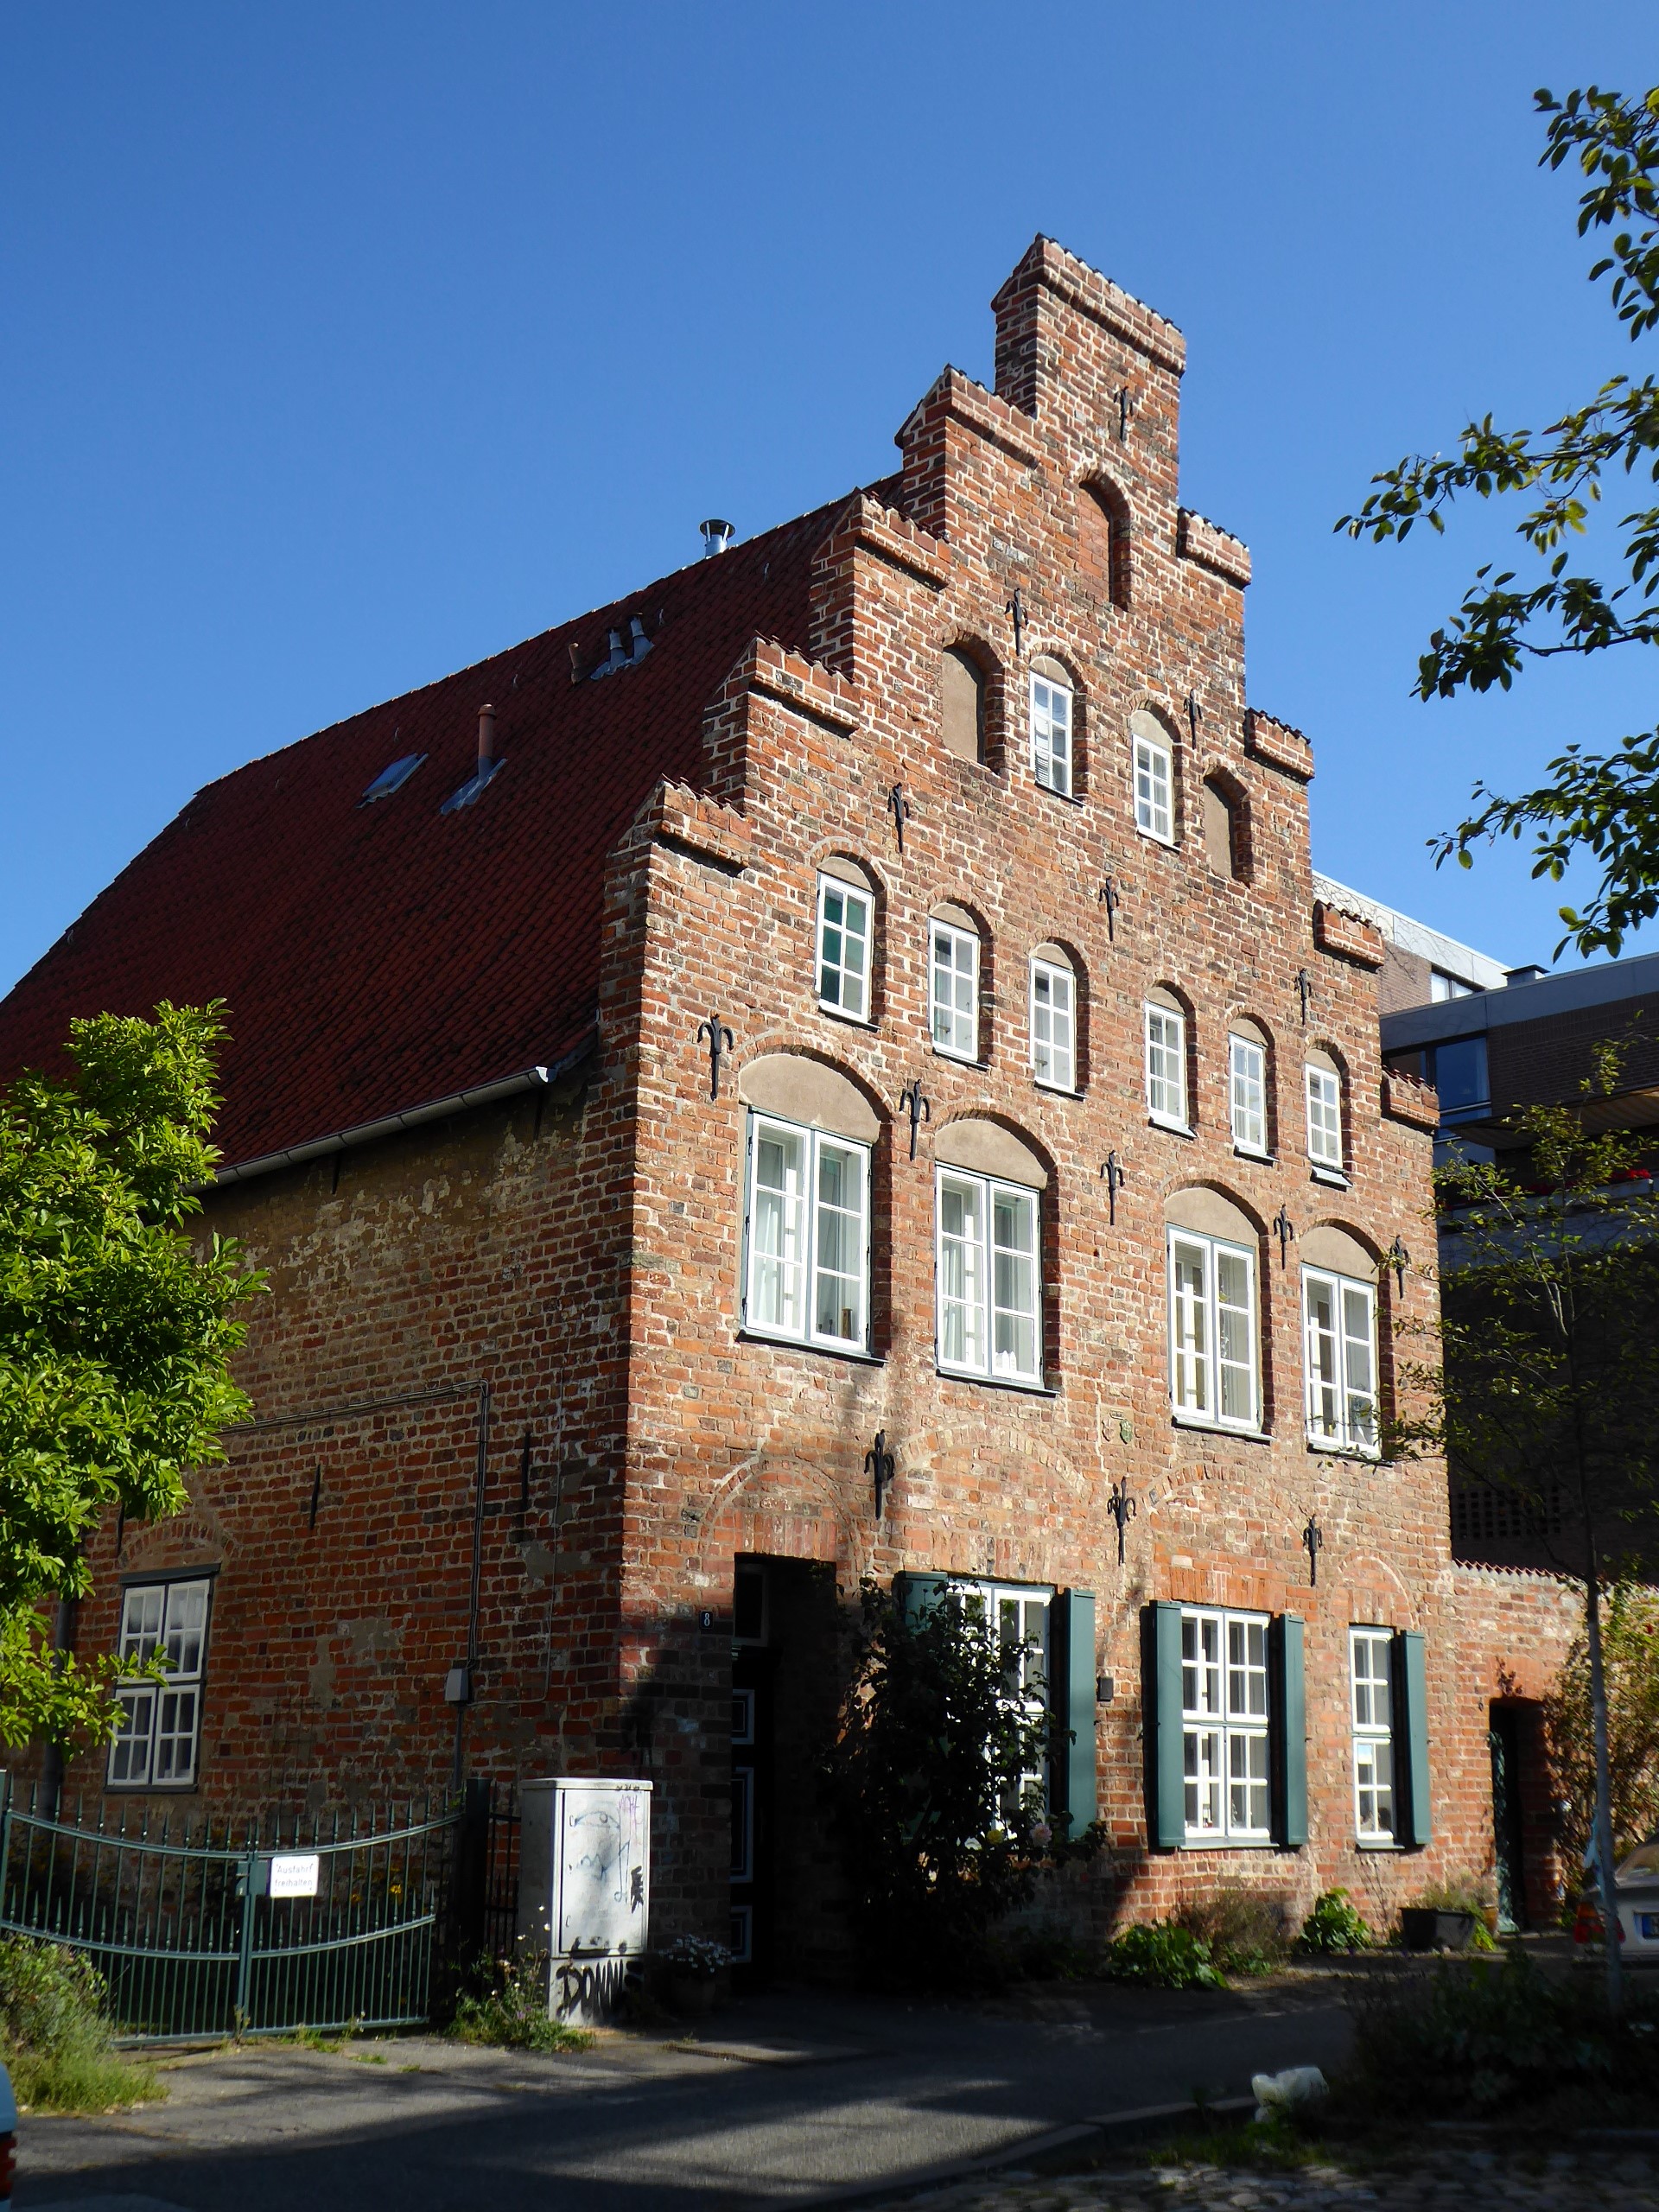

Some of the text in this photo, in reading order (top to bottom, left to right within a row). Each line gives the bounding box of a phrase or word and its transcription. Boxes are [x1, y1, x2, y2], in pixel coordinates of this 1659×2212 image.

[704, 1612, 710, 1626] 8
[277, 1865, 312, 1874] Ausfahrt
[275, 1878, 312, 1887] freihalten
